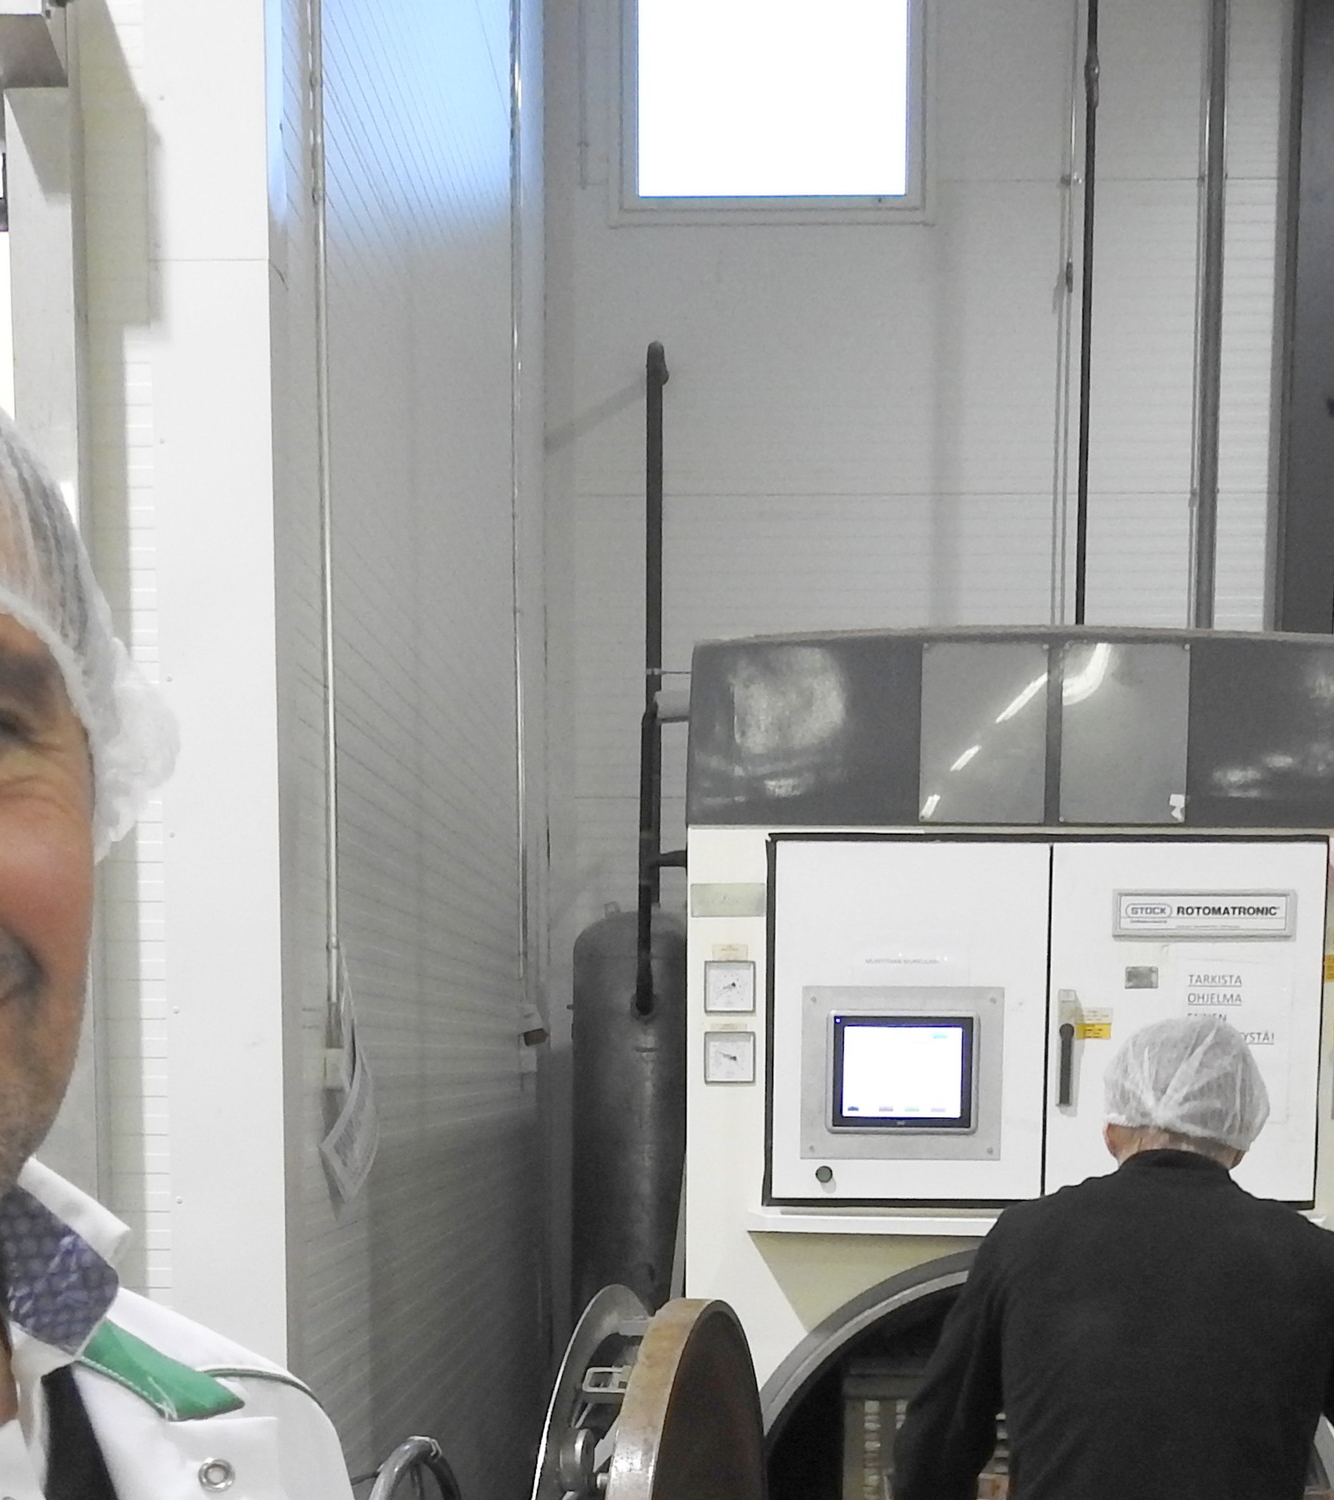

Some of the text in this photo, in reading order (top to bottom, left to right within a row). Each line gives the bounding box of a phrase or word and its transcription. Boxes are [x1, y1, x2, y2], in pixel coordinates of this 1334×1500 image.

[1131, 905, 1278, 916] STOCK ROTOMATRONIC
[1188, 974, 1243, 985] TARKISTA
[1187, 992, 1243, 1004] OHJELMA
